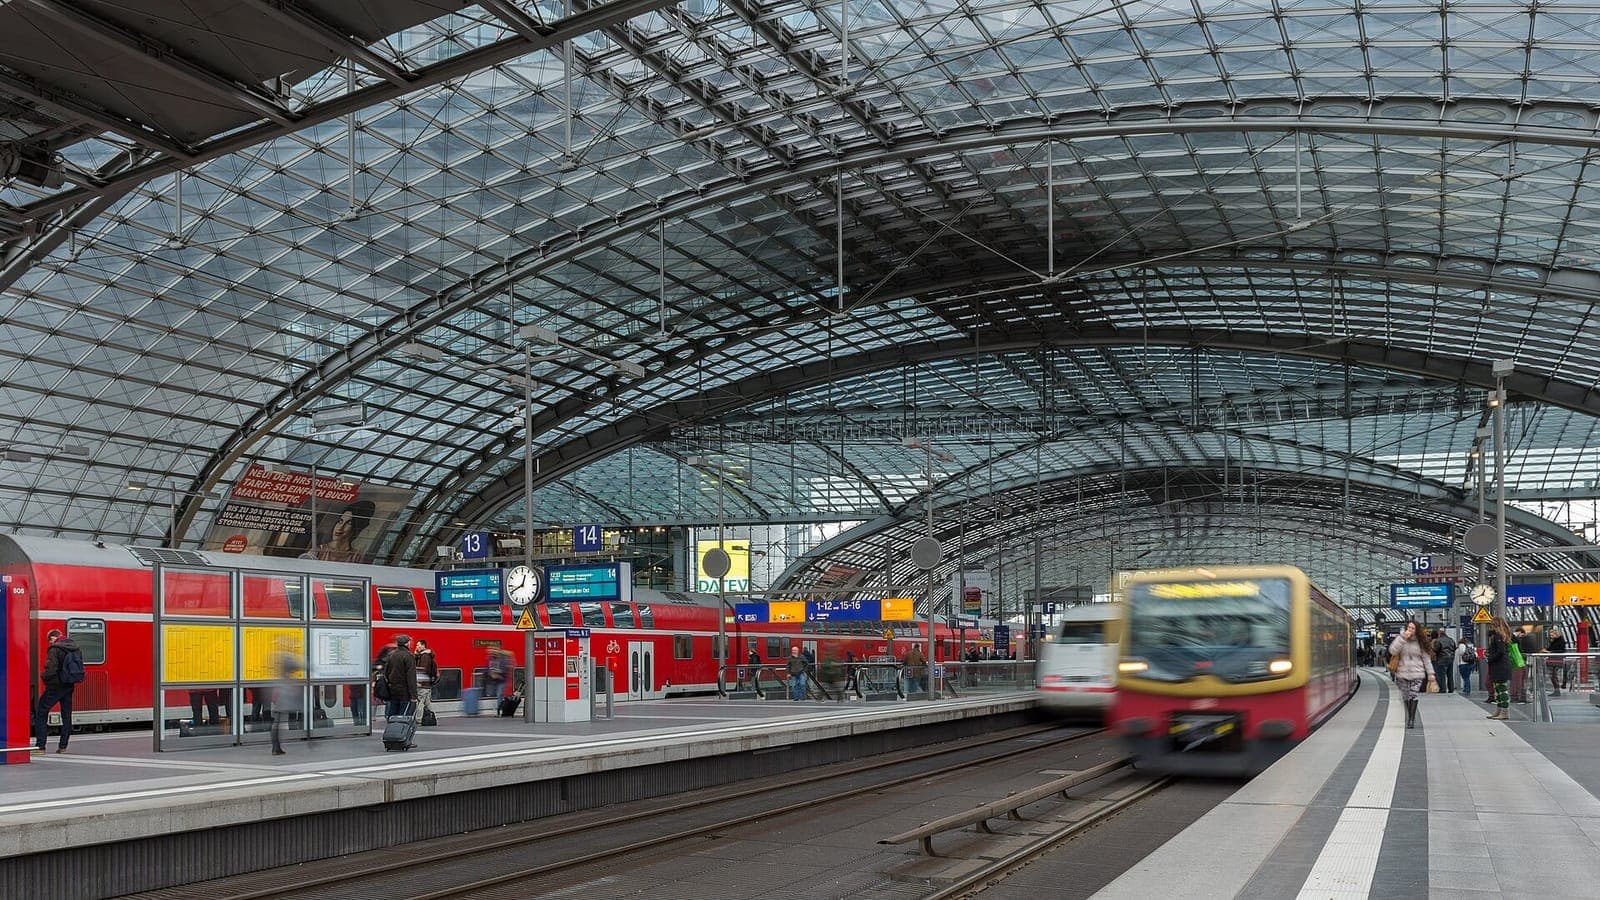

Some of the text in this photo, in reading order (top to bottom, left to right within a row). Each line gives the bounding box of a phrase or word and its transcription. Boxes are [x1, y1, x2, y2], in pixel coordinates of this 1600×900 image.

[272, 471, 292, 482] DER
[293, 475, 312, 486] HRS
[313, 478, 352, 492] USINESS
[235, 487, 301, 503] MAN GÜNSTIG.
[243, 478, 273, 490] TARIF:
[274, 483, 287, 492] SO
[325, 490, 355, 501] BUCHT
[222, 511, 245, 520] WLAN
[580, 526, 597, 544] 14
[464, 534, 480, 552] 13
[1412, 557, 1429, 570] 15
[608, 568, 616, 578] 14
[440, 577, 448, 586] 13
[816, 602, 833, 611] 1-12
[1048, 602, 1054, 612] F
